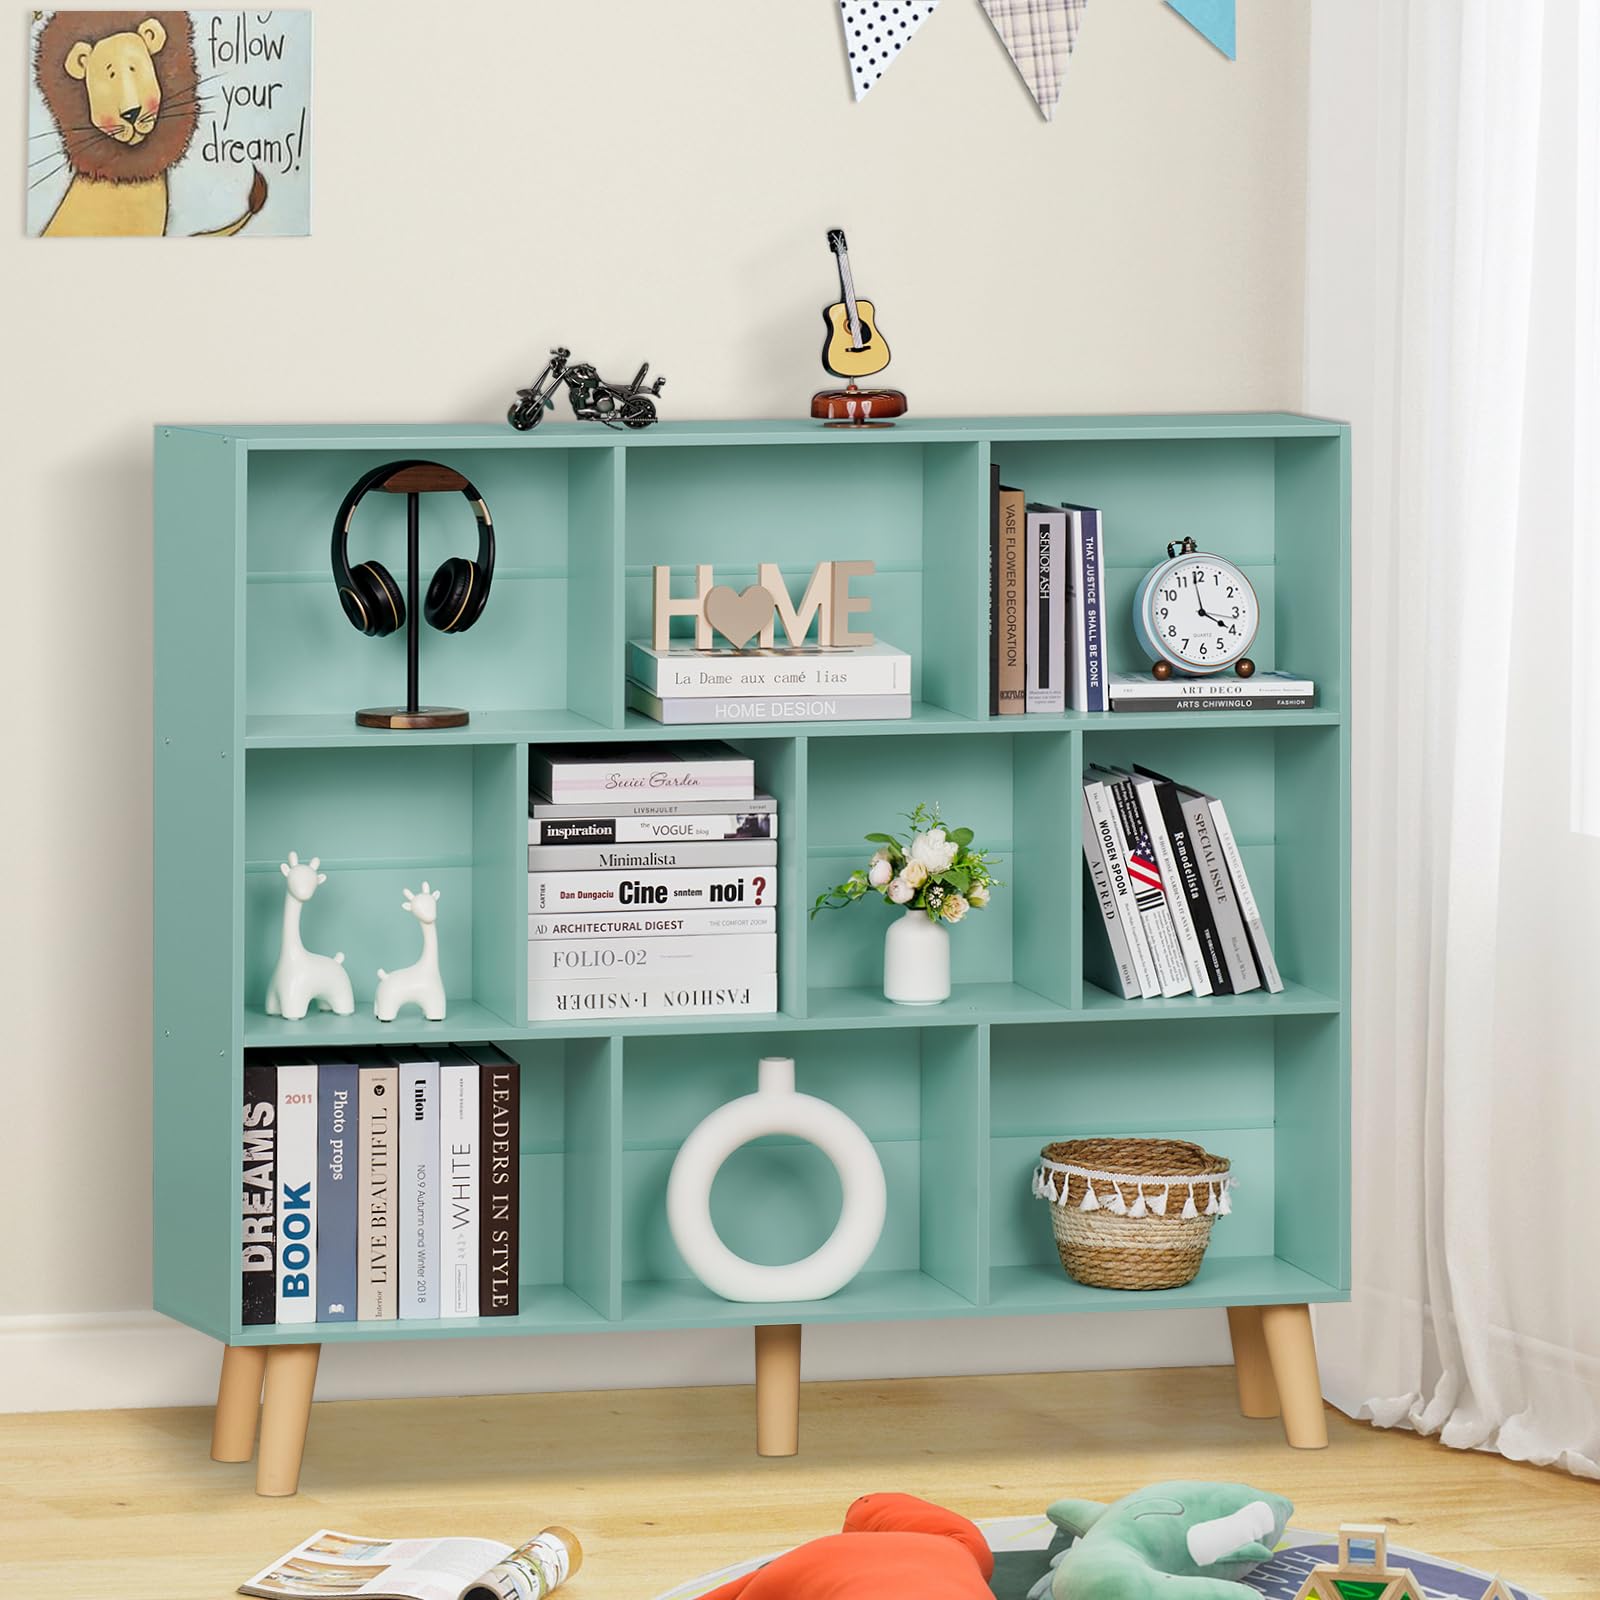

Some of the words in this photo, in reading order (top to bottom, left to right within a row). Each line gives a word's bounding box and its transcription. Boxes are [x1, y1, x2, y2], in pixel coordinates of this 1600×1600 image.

[209, 12, 285, 67] follow
[222, 83, 282, 130] your
[203, 107, 305, 174] dreams!
[1006, 505, 1016, 534] VASE
[1040, 532, 1049, 572] SENIOR
[1086, 537, 1094, 561] THAT
[1007, 538, 1016, 586] FLOWER
[1040, 576, 1049, 599] ASH
[1087, 564, 1095, 604] JUSTICE
[1177, 577, 1187, 587] 11
[1192, 571, 1204, 584] 12
[1214, 575, 1219, 585] 1
[1164, 589, 1177, 601] 10
[1226, 586, 1234, 598] 2
[1161, 608, 1168, 619] 9
[1232, 607, 1239, 618] 3
[1007, 590, 1017, 666] DECORATION
[1088, 610, 1096, 641] SHALL
[1169, 626, 1176, 636] 8
[1229, 624, 1236, 635] 4
[1089, 645, 1097, 657] BE
[1181, 639, 1189, 650] 7
[1200, 643, 1207, 654] 6
[1217, 638, 1224, 649] 5
[675, 672, 690, 685] La
[700, 671, 732, 684] Dame
[741, 673, 765, 683] aux
[774, 671, 806, 683] camé
[816, 671, 847, 683] lias
[1090, 661, 1098, 687] DONE
[715, 703, 767, 718] HOME
[1177, 700, 1199, 708] ARTS
[1203, 699, 1252, 708] CHIWINGLO
[649, 772, 700, 787] Garden
[547, 824, 612, 839] inspiration
[653, 825, 693, 835] VOGUE
[600, 852, 676, 867] Minimalista
[1099, 819, 1116, 861] WOODEN
[1111, 863, 1127, 896] SPOON
[1158, 836, 1167, 856] WHOSE
[1169, 875, 1180, 900] GARDEN
[1174, 831, 1200, 899] Remodelista
[1193, 812, 1216, 866] SPECIAL
[1209, 868, 1227, 904] ISSUE
[560, 891, 575, 899] Dan
[578, 890, 613, 900] Dungaciu
[619, 881, 667, 904] Cine
[710, 879, 744, 902] noi
[752, 877, 766, 905] ?
[1091, 859, 1115, 920] ALPRED
[535, 925, 547, 934] AD
[553, 922, 642, 934] ARCHITECTURAL
[645, 920, 683, 931] DIGEST
[553, 950, 647, 968] FOLIO-02
[1203, 928, 1211, 939] THE
[1207, 939, 1219, 968] ORGANIZED
[1215, 968, 1223, 984] HOME
[1121, 963, 1131, 986] HOME
[664, 989, 750, 1006] FASHION
[285, 1095, 312, 1104] 2011
[414, 1080, 426, 1120] Union
[334, 1091, 347, 1132] Photo
[493, 1074, 509, 1184] LEADERS
[330, 1140, 345, 1180] props
[371, 1108, 387, 1228] BEAUTIFUL
[242, 1102, 275, 1272] DREAMS
[416, 1165, 425, 1188] NO.9
[452, 1144, 471, 1229] WHITE
[417, 1191, 426, 1226] Autumn
[493, 1195, 509, 1218] IN
[283, 1182, 310, 1298] BOOK
[417, 1229, 426, 1248] and
[371, 1235, 387, 1284] LIVE
[417, 1251, 426, 1277] Winter
[493, 1231, 509, 1307] STYLE
[417, 1280, 426, 1303] 2018
